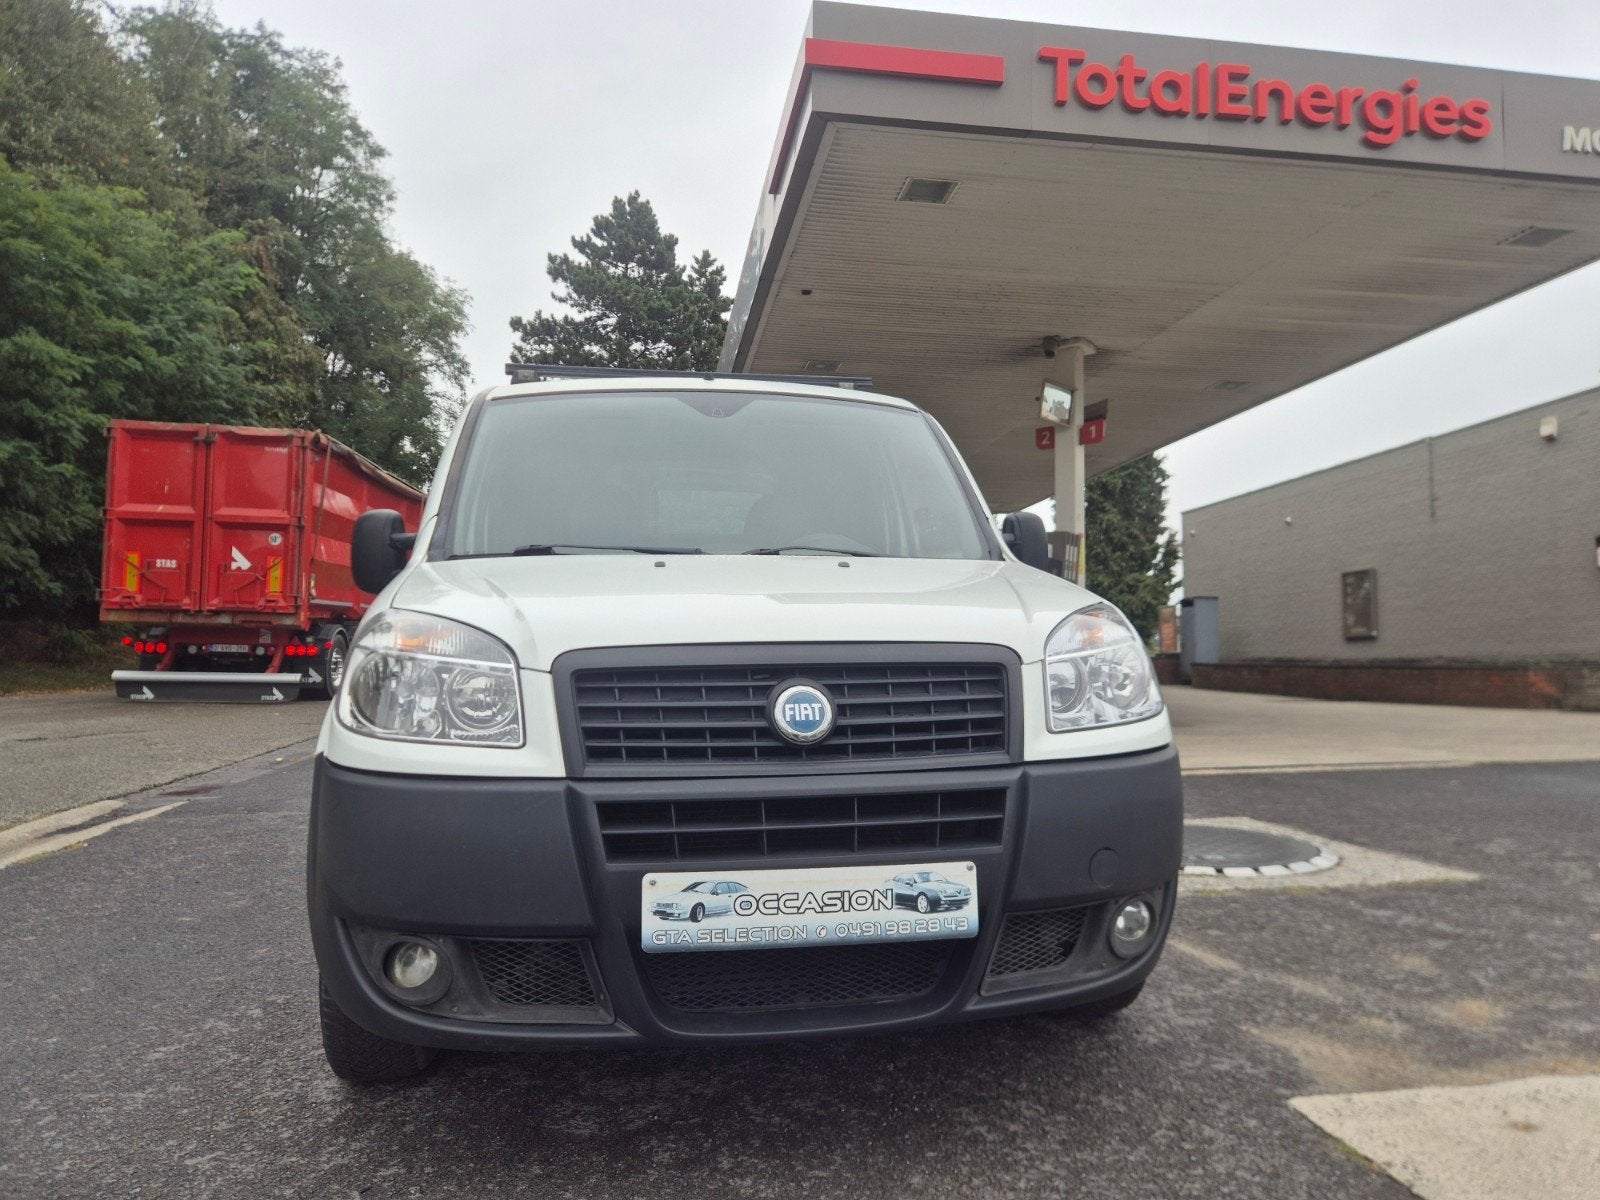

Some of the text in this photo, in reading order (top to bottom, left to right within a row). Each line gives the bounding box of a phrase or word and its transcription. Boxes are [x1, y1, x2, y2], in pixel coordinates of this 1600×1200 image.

[1037, 46, 1493, 148] TotalEnergies
[1041, 431, 1051, 445] 2
[1089, 425, 1096, 439] 1
[156, 559, 177, 568] STAS
[784, 703, 822, 721] FIAT
[733, 888, 894, 916] OCCASION
[652, 916, 969, 945] GTA SELECTION 0491 98 28 43
